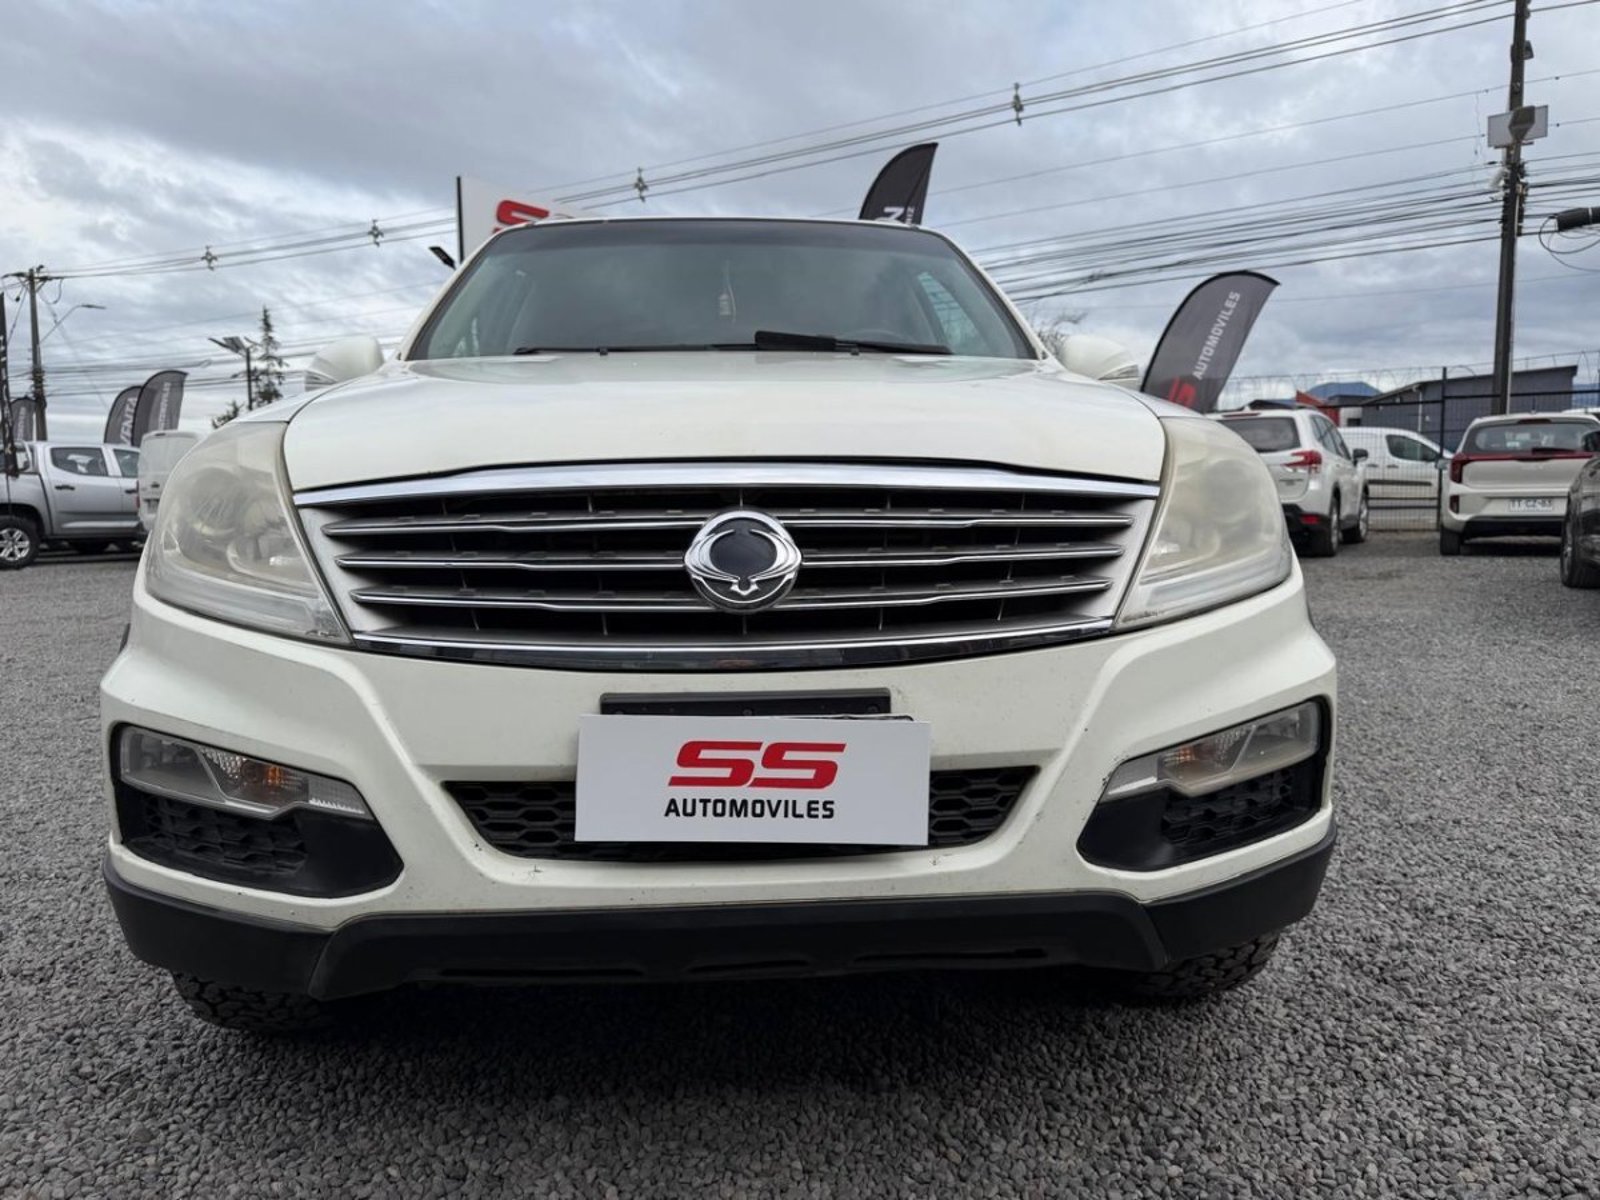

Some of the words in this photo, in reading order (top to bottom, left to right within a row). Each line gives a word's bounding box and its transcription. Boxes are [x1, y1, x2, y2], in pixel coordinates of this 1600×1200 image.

[1192, 291, 1241, 381] AUTOMOVILES
[668, 740, 847, 789] SS
[664, 798, 835, 819] AUTOMOVILES
